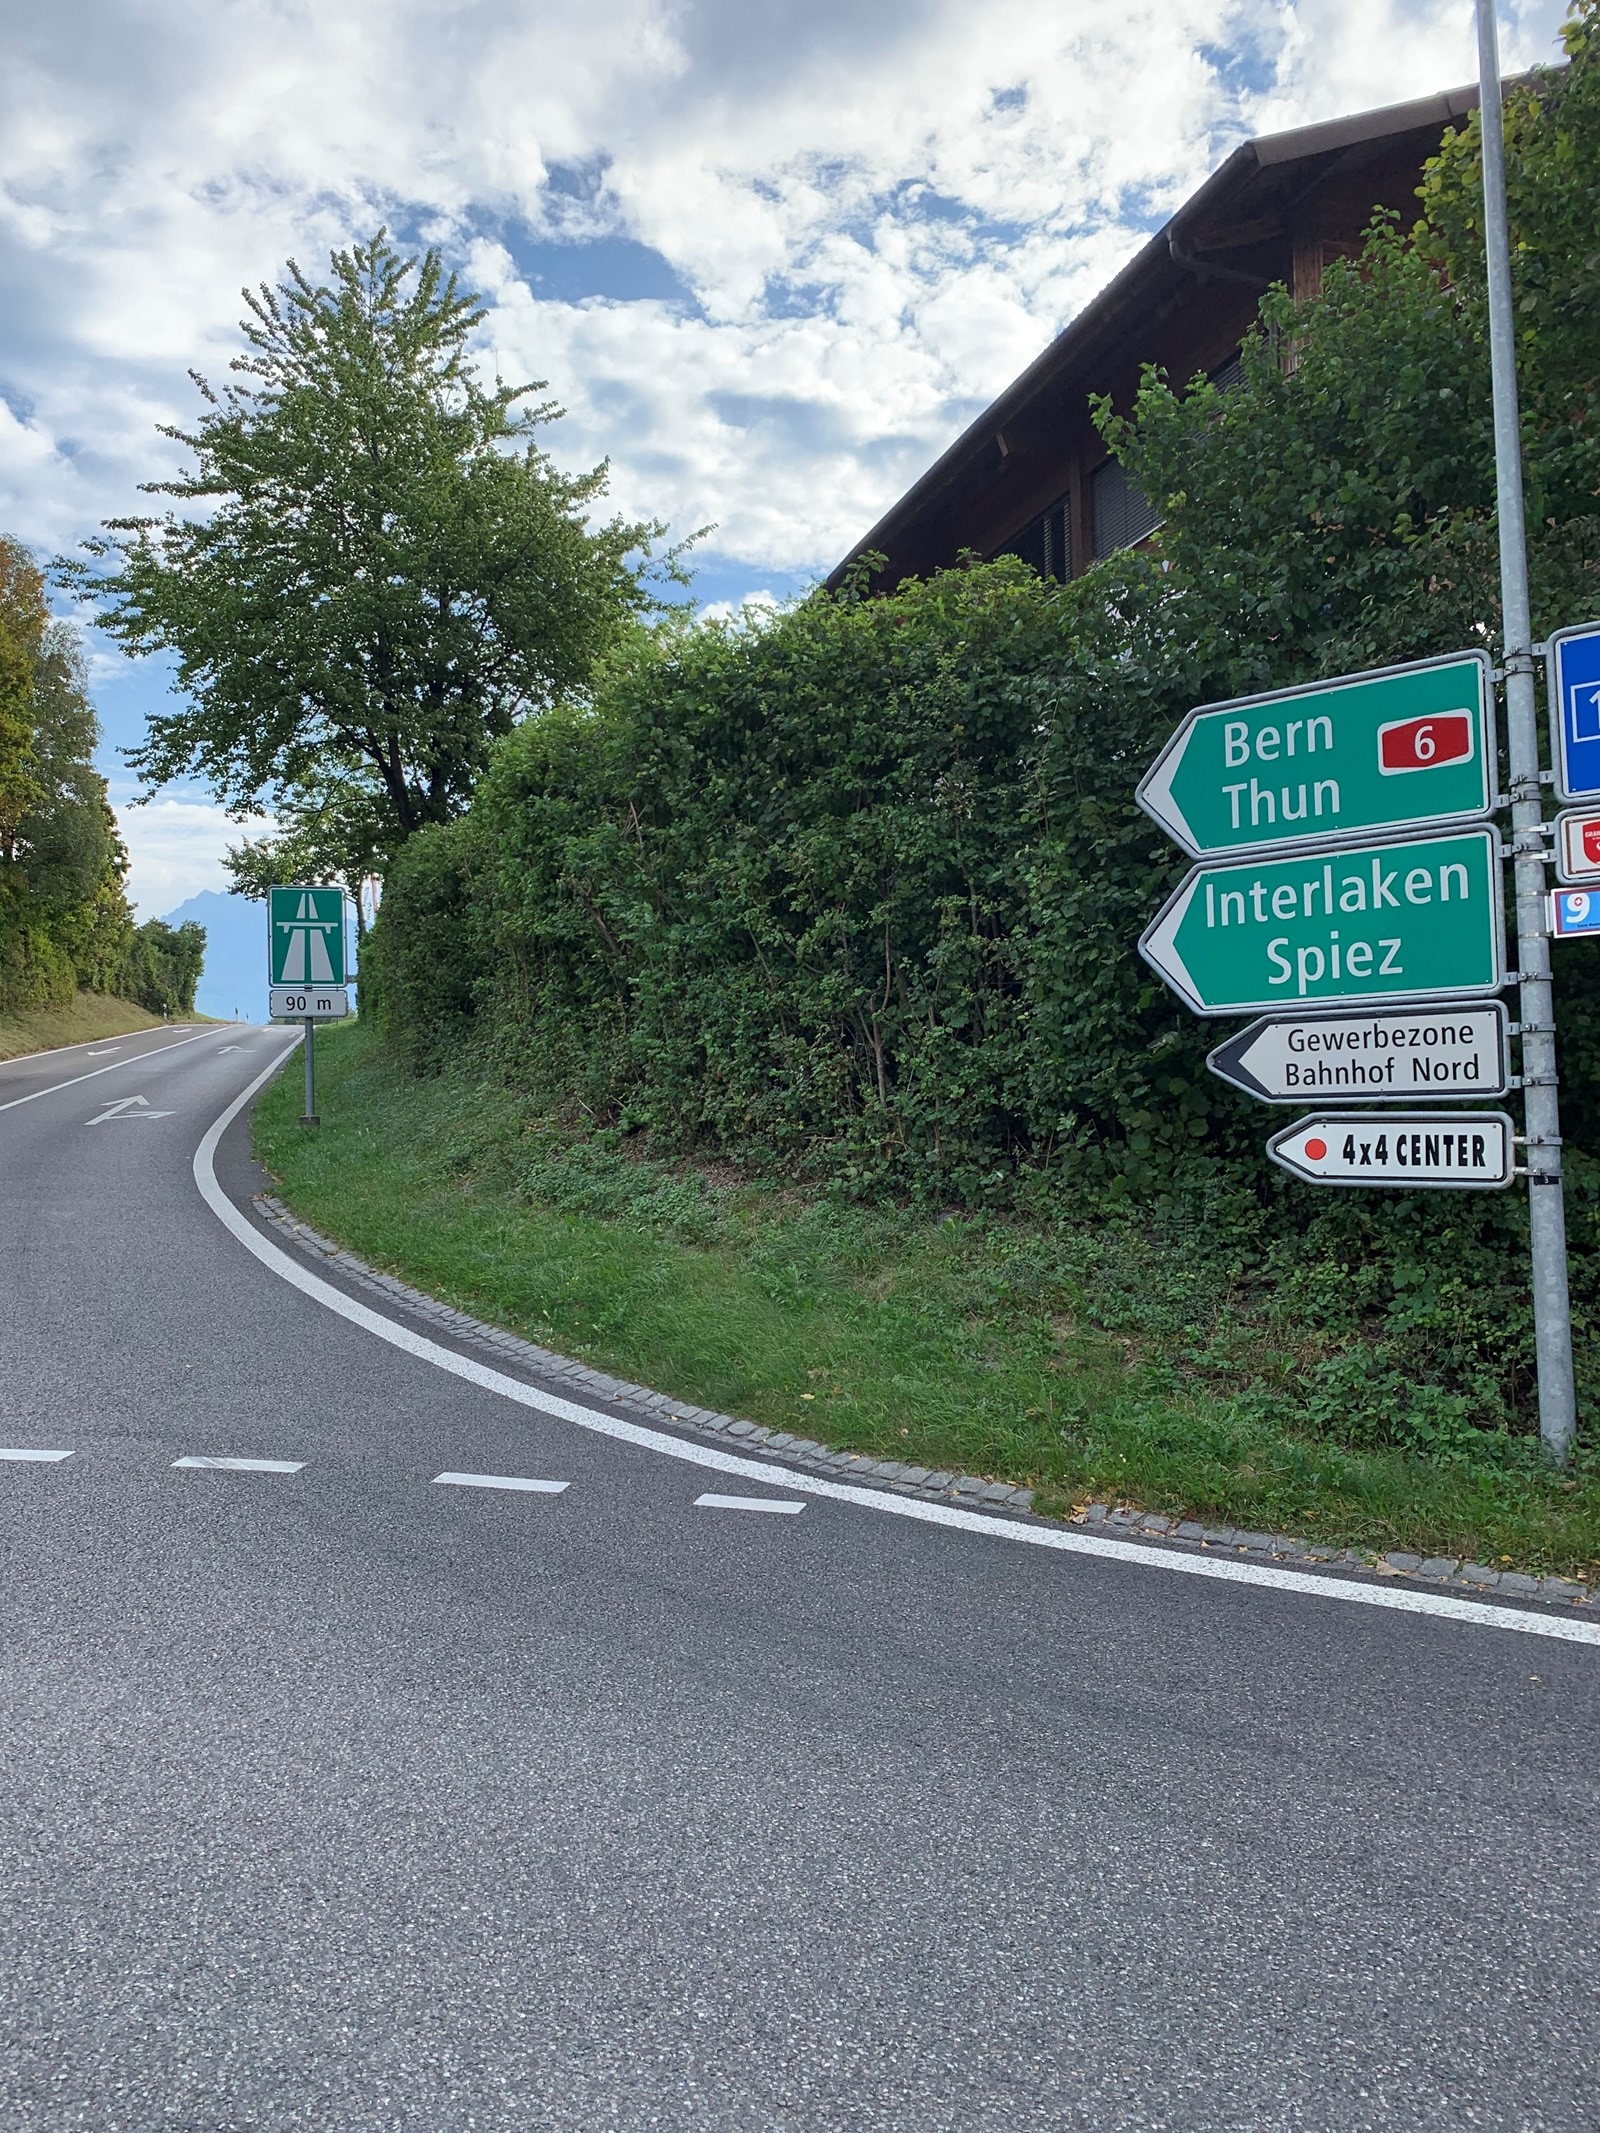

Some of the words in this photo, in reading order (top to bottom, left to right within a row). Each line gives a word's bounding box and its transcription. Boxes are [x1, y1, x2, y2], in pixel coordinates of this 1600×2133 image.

[1223, 713, 1333, 768] Bern
[1413, 724, 1437, 760] 6
[1221, 777, 1341, 830] Thun
[1205, 858, 1469, 928] Interlaken
[1565, 892, 1591, 924] 9
[1266, 930, 1405, 996] Spiez
[285, 995, 307, 1012] 90
[316, 998, 332, 1011] m
[1287, 1021, 1474, 1053] Gewerbezone
[1285, 1056, 1395, 1087] Bahnhof
[1412, 1053, 1480, 1082] Nord
[1342, 1134, 1389, 1166] 4x4
[1396, 1133, 1486, 1168] CENTER
